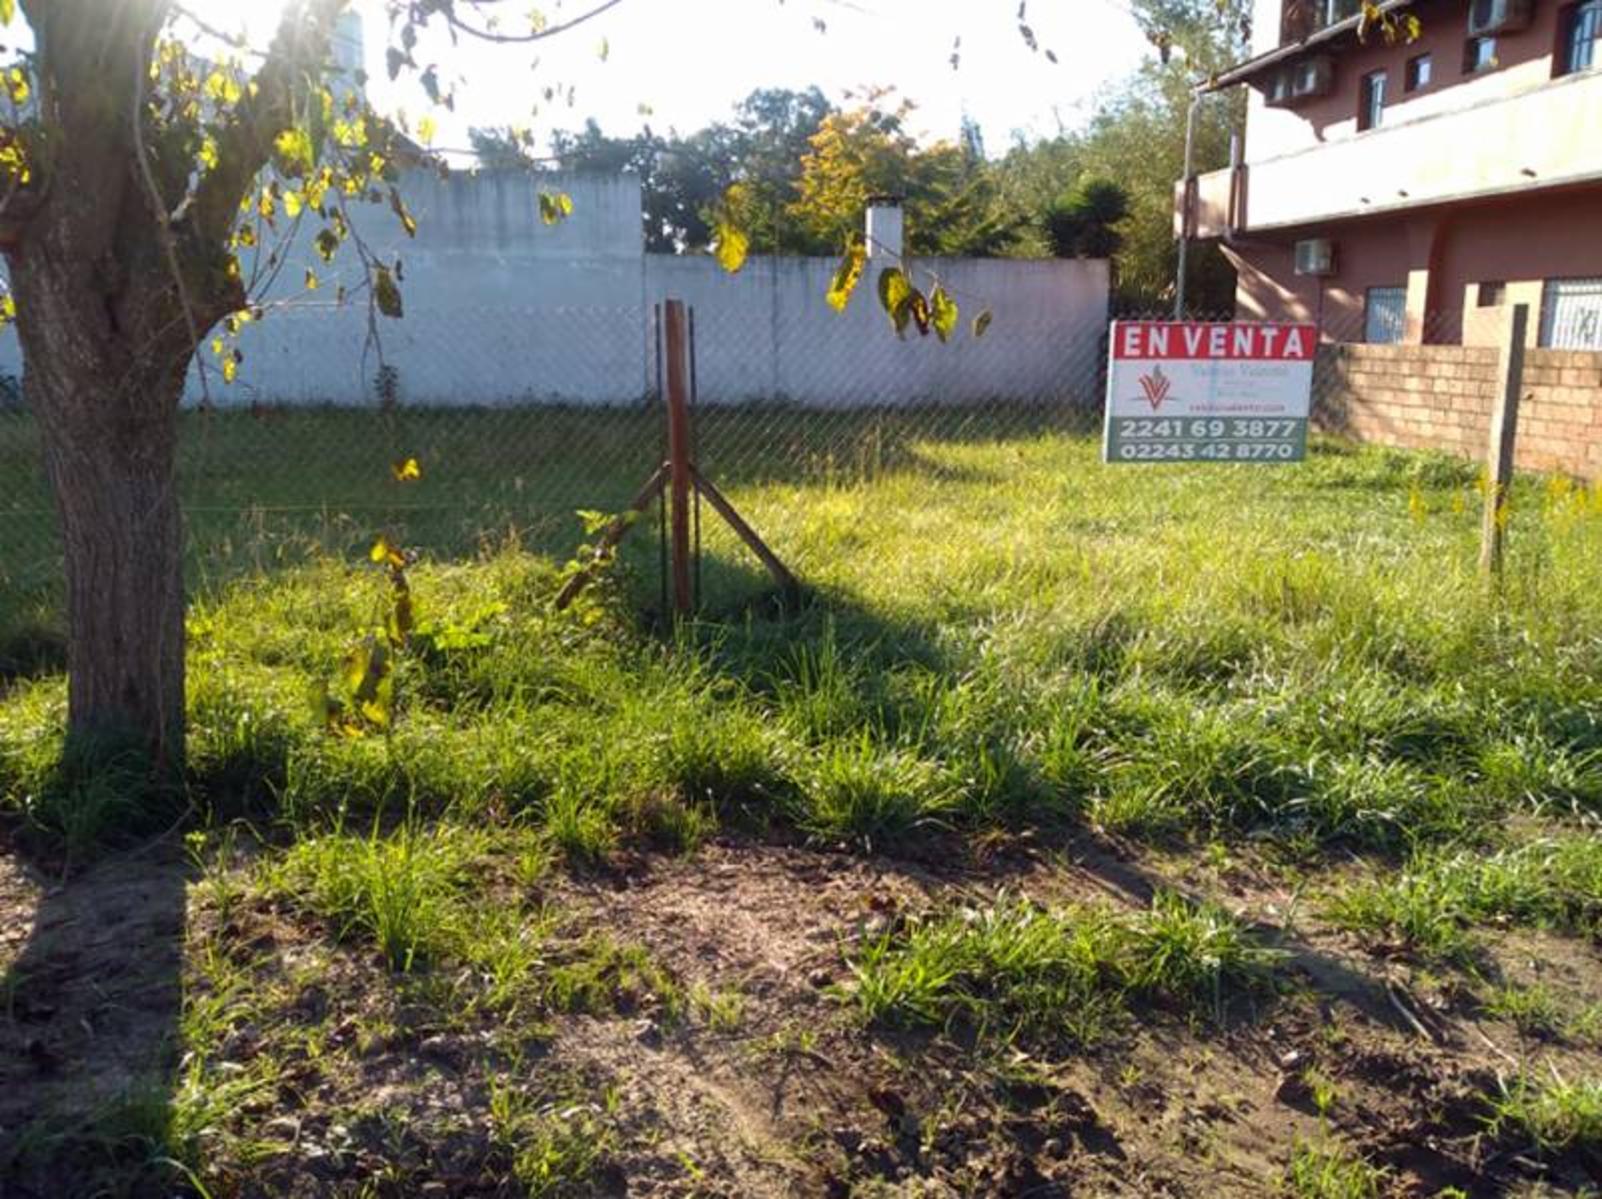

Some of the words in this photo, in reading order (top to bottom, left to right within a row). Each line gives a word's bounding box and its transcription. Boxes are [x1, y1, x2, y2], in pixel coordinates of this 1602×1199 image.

[1124, 326, 1169, 356] EN
[1183, 325, 1304, 357] VENTA
[1120, 419, 1182, 437] 2241
[1191, 419, 1225, 437] 69
[1232, 419, 1298, 437] 3877
[1120, 443, 1194, 459] 02243
[1200, 443, 1230, 459] 42
[1236, 443, 1293, 459] 8770
